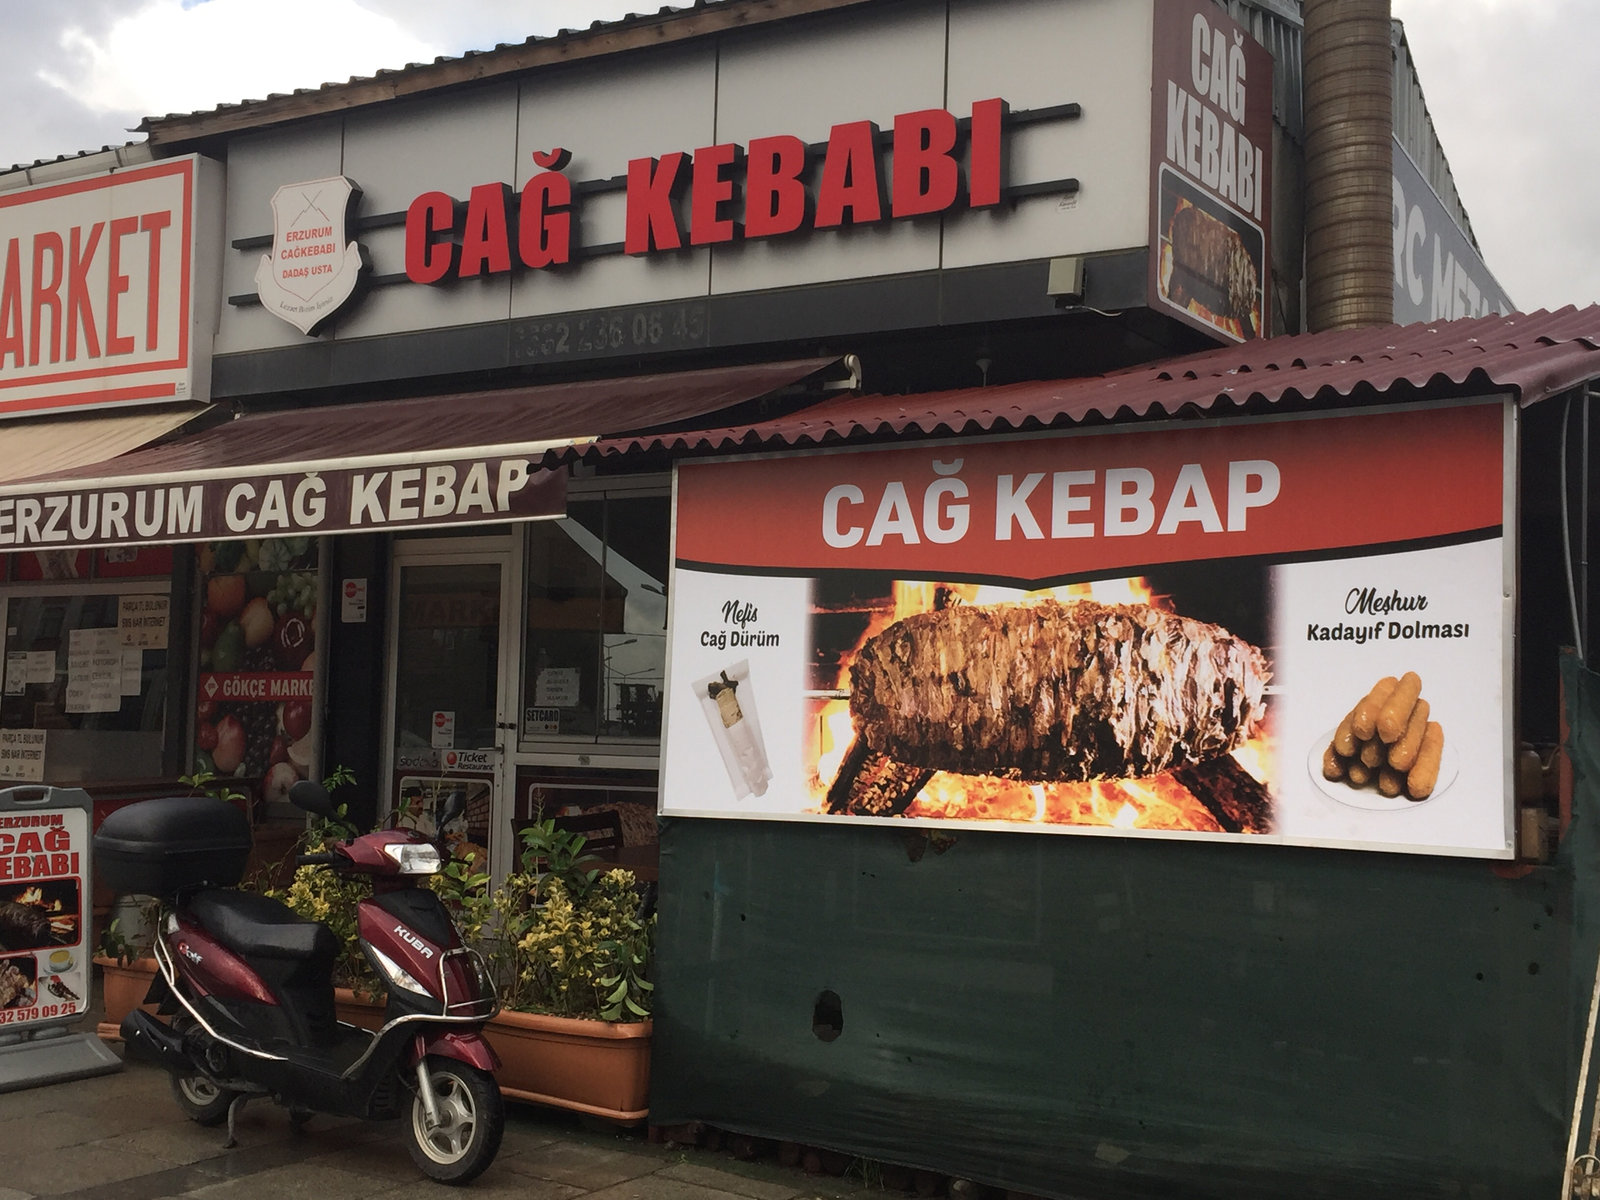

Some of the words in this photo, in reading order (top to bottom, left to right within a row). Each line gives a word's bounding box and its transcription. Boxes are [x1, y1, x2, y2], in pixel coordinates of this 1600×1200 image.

[1190, 12, 1246, 126] CAĞ
[1166, 79, 1263, 221] KEBABI
[405, 148, 572, 284] CAĞ
[624, 98, 1009, 256] KEBABI
[286, 226, 333, 243] ERZURUM
[280, 242, 336, 260] CAĞKEBABI
[282, 266, 310, 280] DADAŞ
[311, 264, 334, 275] USTA
[0, 486, 204, 545] ERZURUM
[225, 472, 327, 534] CAĞ
[349, 459, 529, 525] KEBAP
[821, 458, 971, 549] CAĞ
[995, 458, 1281, 541] KEBAP
[720, 598, 759, 630] Nefis
[1343, 587, 1429, 616] Meşhur
[699, 628, 728, 651] Cağ
[729, 629, 780, 649] Dürüm
[1306, 620, 1383, 645] Kadayıf
[1387, 621, 1470, 640] Dolması
[223, 675, 266, 698] GÖKÇE
[526, 709, 559, 722] SETCARD
[457, 751, 488, 763] Ticket
[457, 762, 495, 772] Restaurant
[0, 826, 71, 856] CAĞ
[393, 925, 434, 959] KUBA
[17, 1007, 39, 1021] 579
[42, 1004, 58, 1018] 09
[60, 1002, 77, 1015] 25
